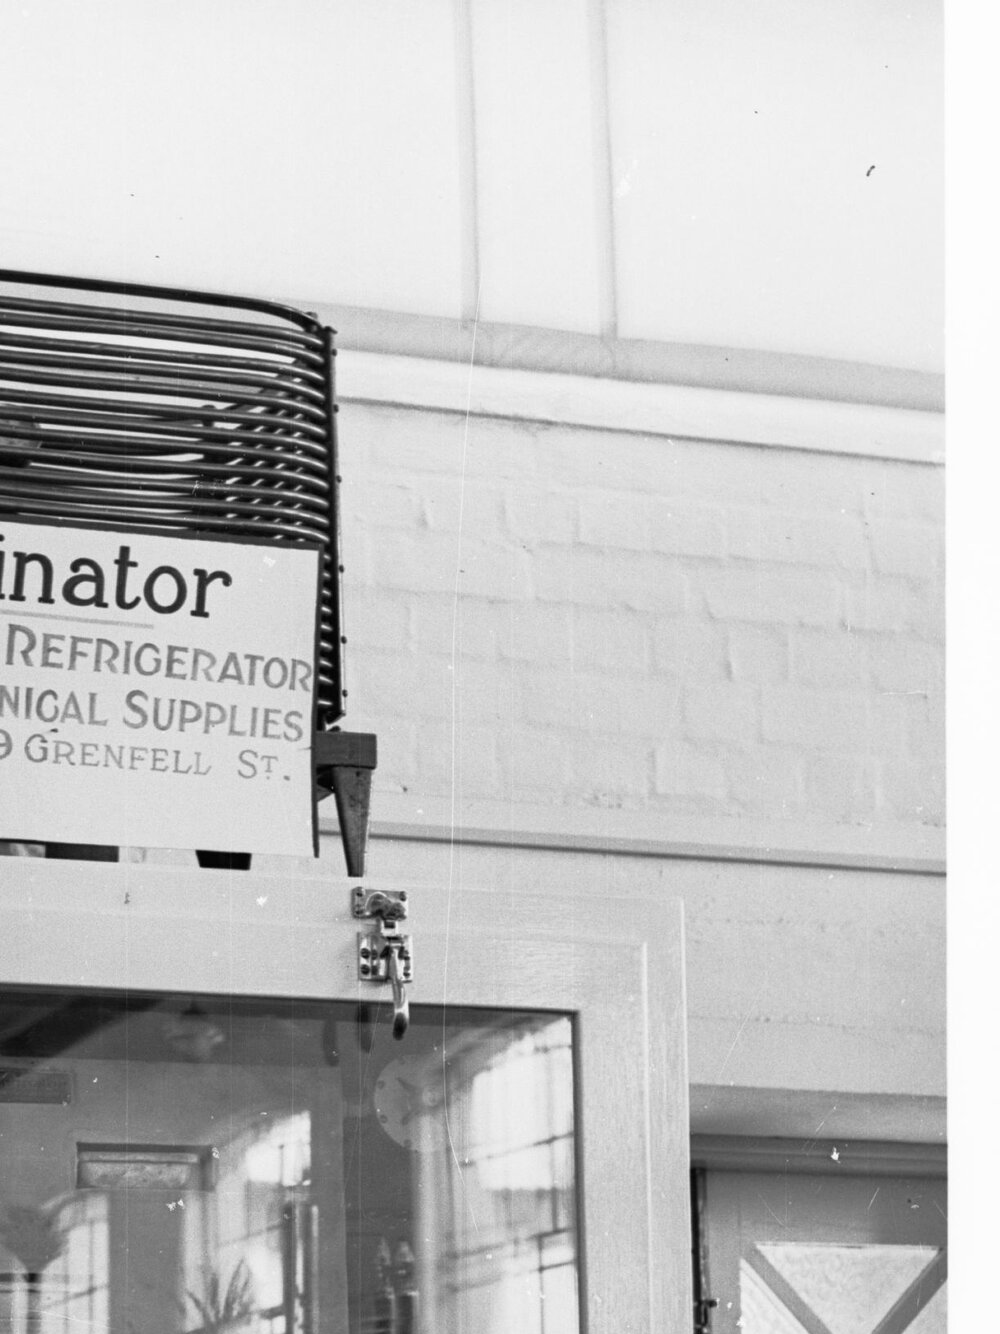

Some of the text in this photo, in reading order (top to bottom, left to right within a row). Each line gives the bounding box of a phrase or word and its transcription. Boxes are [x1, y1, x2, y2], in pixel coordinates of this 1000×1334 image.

[5, 624, 313, 693] REFRIGERATOR
[123, 690, 304, 744] SUPPLIES
[24, 734, 212, 776] GRENFELL
